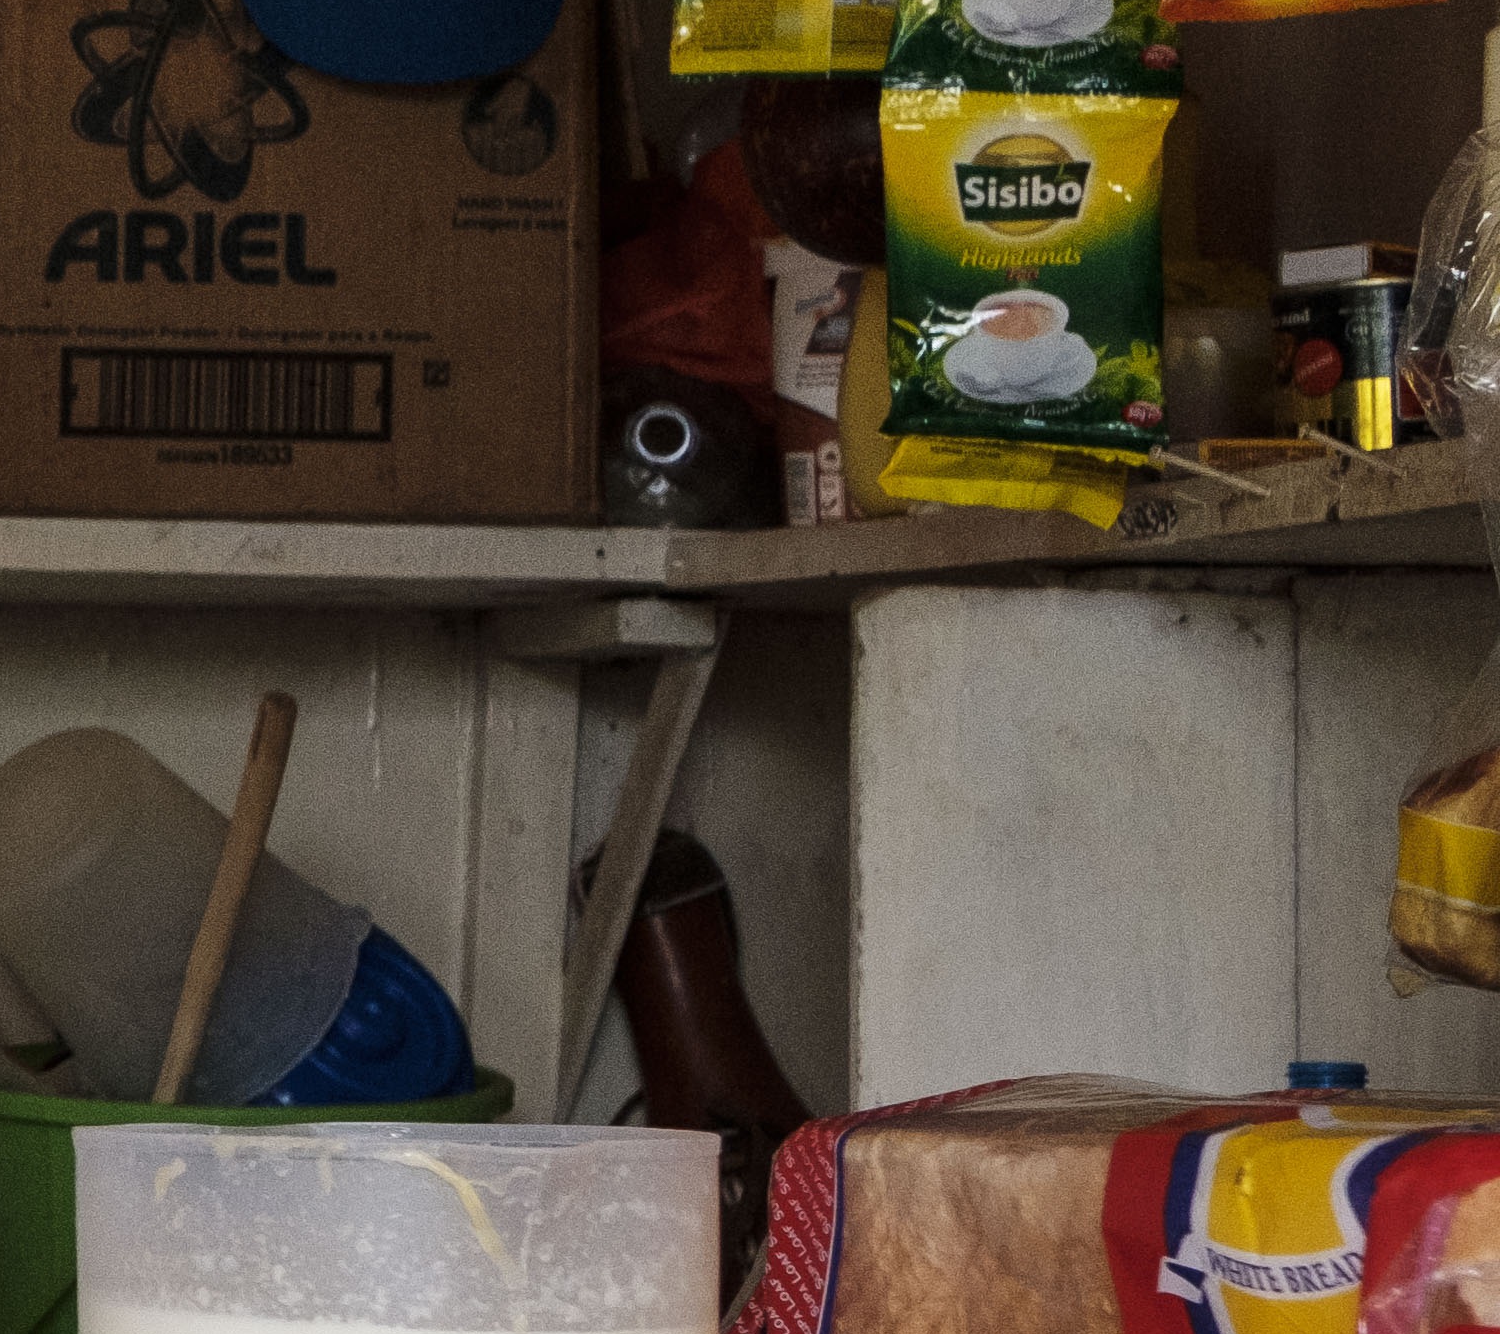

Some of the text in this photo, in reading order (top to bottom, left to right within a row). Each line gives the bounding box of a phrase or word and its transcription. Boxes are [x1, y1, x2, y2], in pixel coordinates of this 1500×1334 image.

[963, 175, 1083, 209] Sisibo
[44, 209, 338, 287] ARIEL
[960, 247, 1083, 271] Highlands
[1206, 1247, 1364, 1293] WHITE BREAD
